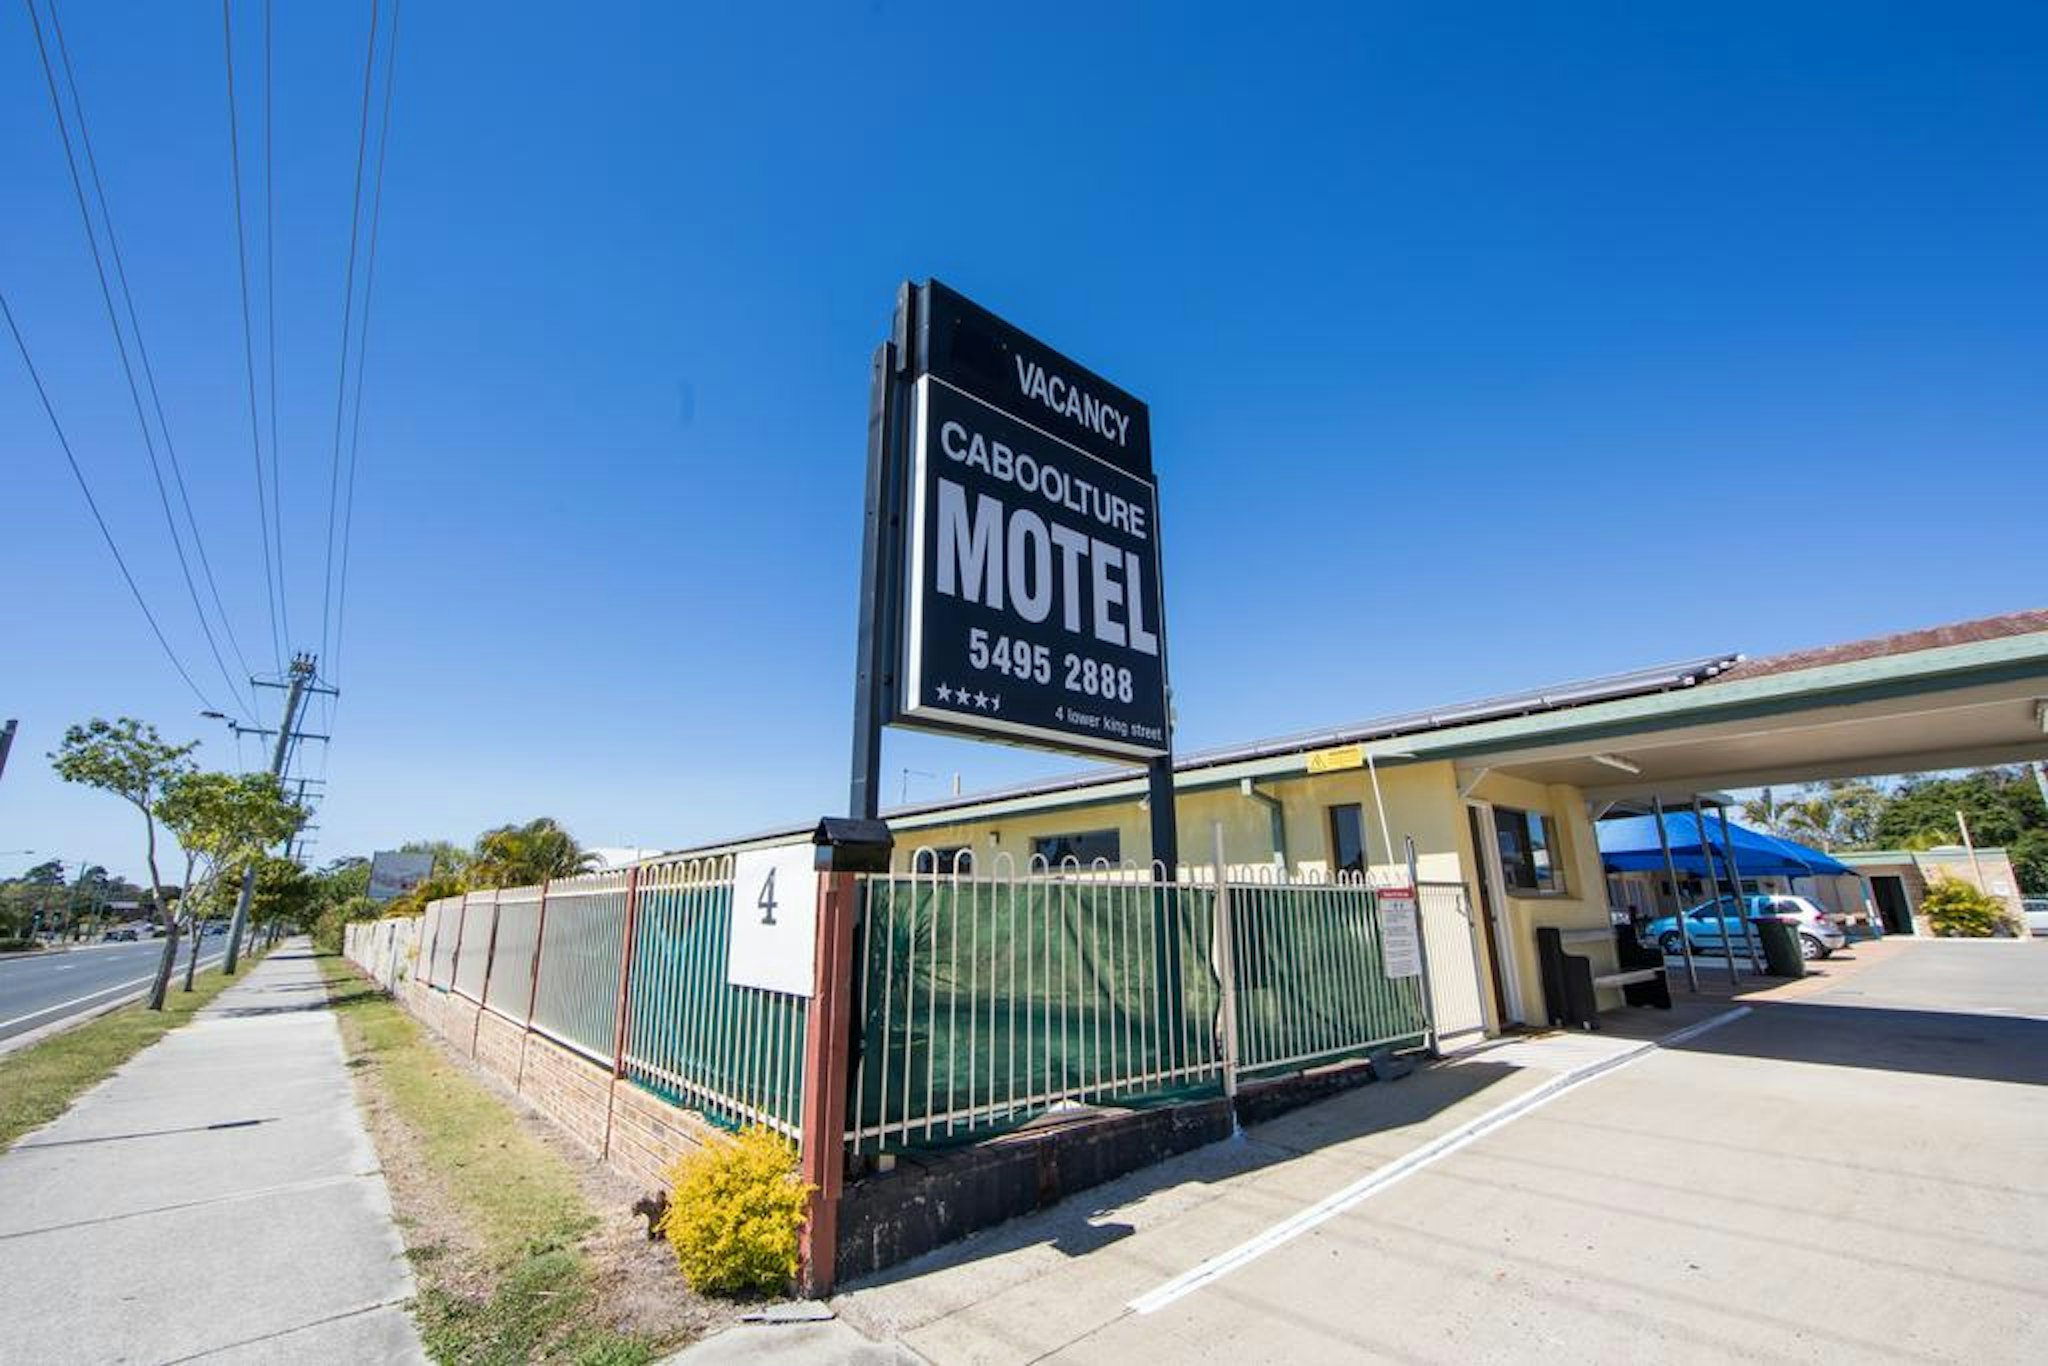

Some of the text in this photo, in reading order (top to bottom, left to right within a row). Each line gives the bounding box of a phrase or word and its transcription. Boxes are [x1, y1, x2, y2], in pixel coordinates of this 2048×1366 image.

[1015, 354, 1130, 447] VACANCY
[941, 421, 1147, 539] CABOOLTURE
[936, 476, 1158, 655] MOTEL
[969, 628, 1133, 703] 5495 2888
[1055, 706, 1063, 720] 4
[1103, 715, 1128, 737] king
[1131, 723, 1162, 741] street
[758, 866, 778, 926] 4
